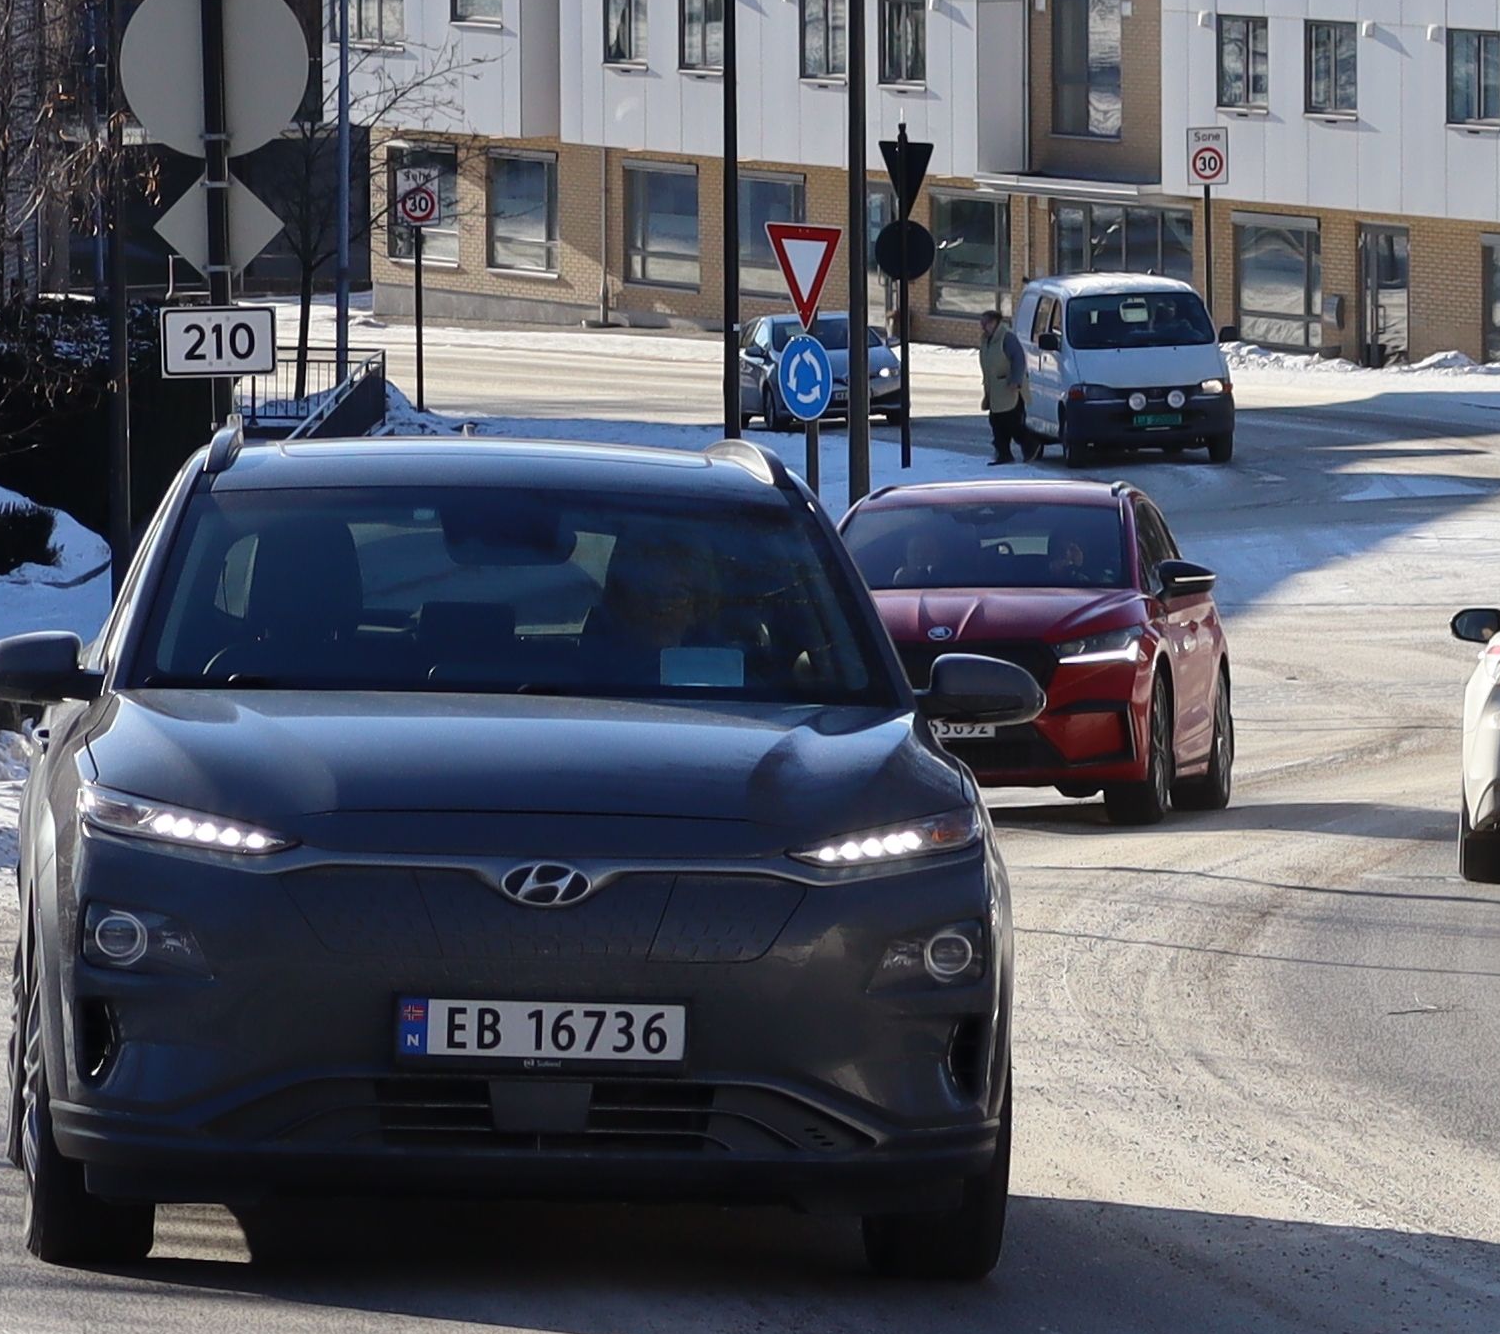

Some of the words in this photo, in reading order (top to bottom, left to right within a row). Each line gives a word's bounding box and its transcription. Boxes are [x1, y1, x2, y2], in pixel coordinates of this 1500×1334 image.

[1194, 131, 1221, 142] Sone
[1199, 156, 1218, 172] 30
[408, 195, 429, 213] 30
[183, 322, 255, 361] 210
[407, 1035, 419, 1047] N
[446, 1007, 502, 1050] EB
[527, 1009, 667, 1054] 16736
